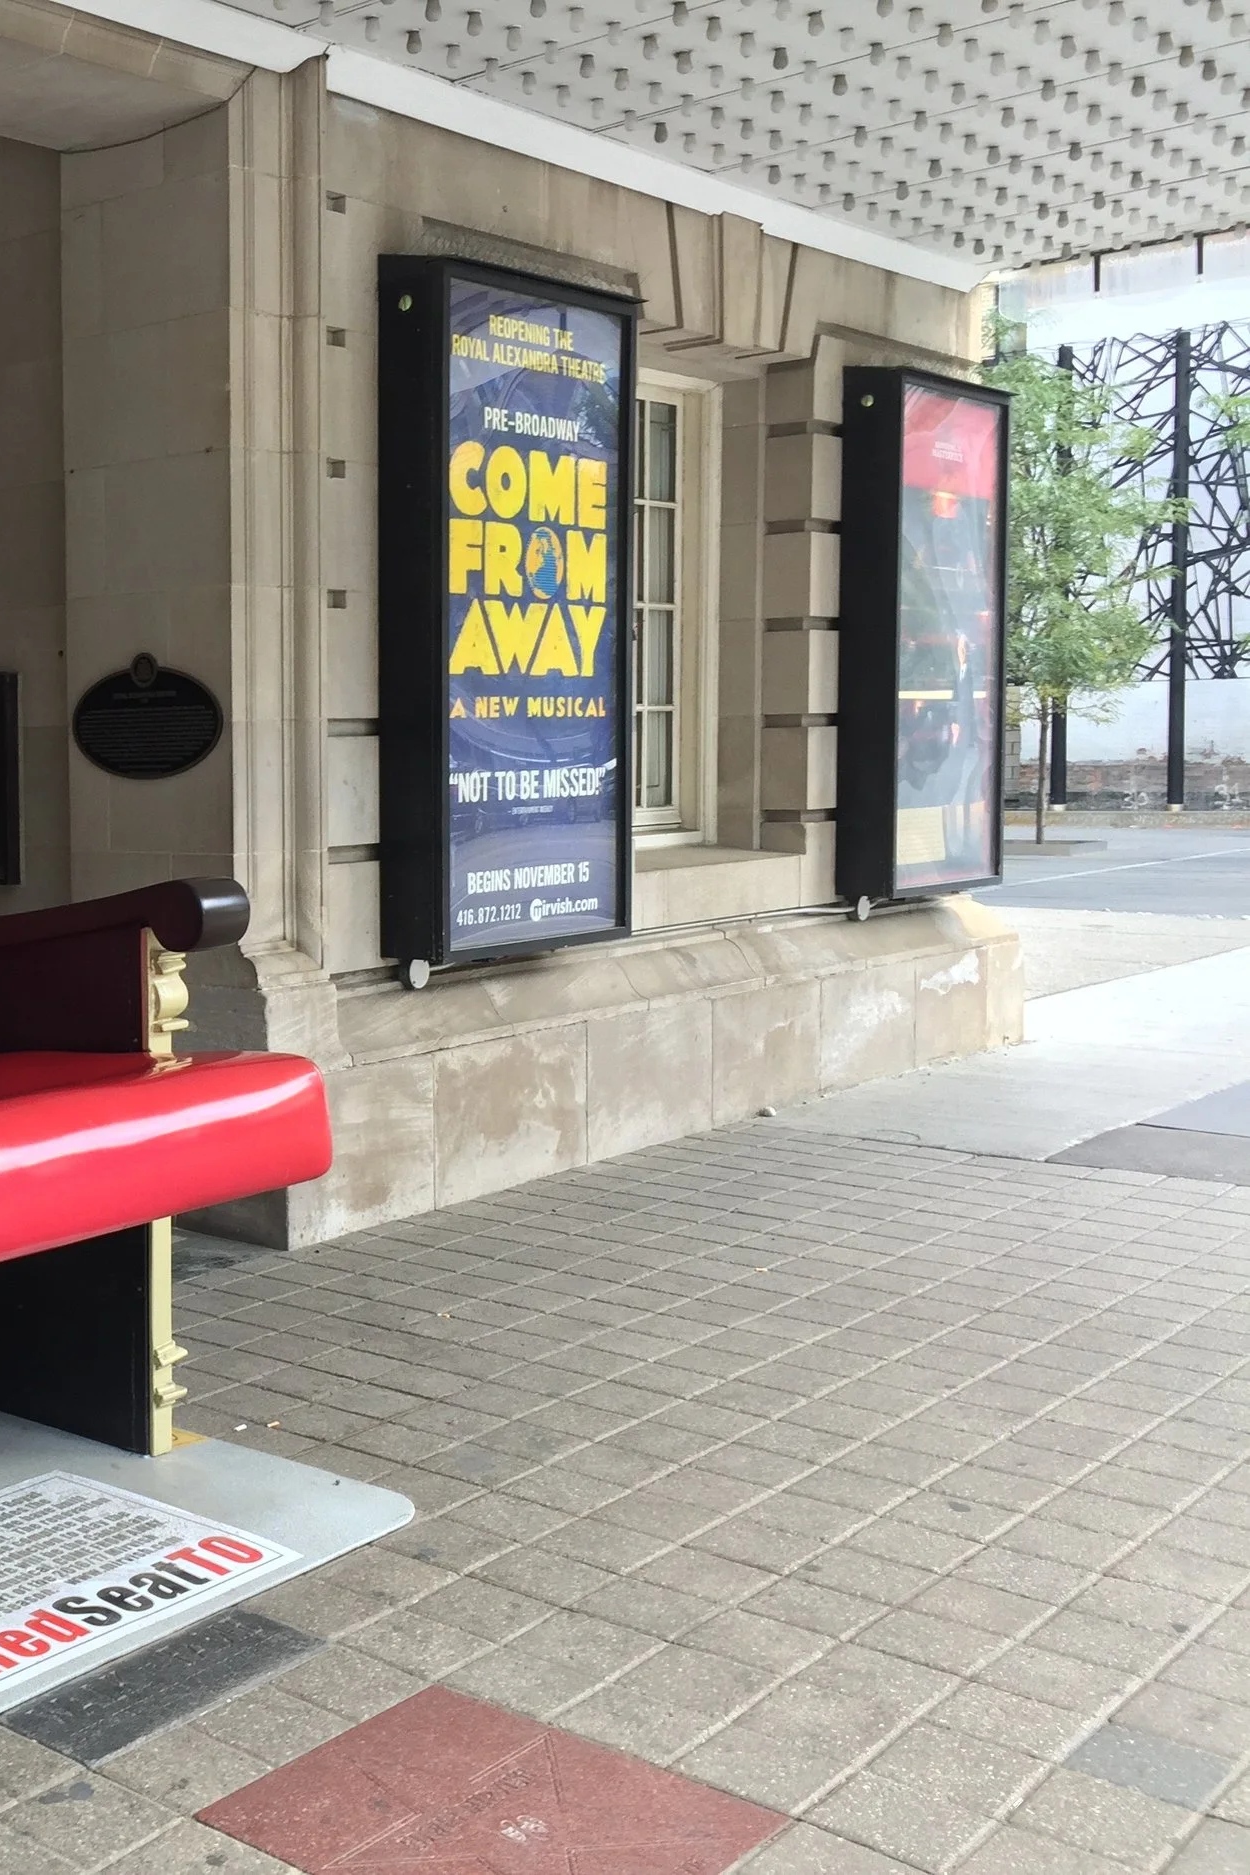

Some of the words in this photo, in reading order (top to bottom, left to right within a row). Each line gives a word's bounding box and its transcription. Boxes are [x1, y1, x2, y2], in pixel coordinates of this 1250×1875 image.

[489, 315, 550, 351] REOPENING
[553, 327, 574, 351] THE
[452, 334, 490, 362] ROYAL
[493, 340, 559, 374] ALEXANDRA
[560, 356, 606, 384] THEATRE
[484, 406, 580, 442] PRE-BROADWAY
[449, 441, 608, 530] COME
[448, 517, 606, 603] FROM
[449, 598, 606, 677] AWAY
[449, 700, 466, 719] A
[475, 696, 519, 718] NEW
[527, 696, 606, 718] MUSICAL
[495, 771, 515, 801] TO
[520, 770, 540, 800] BE
[467, 869, 510, 895] BEGINS
[514, 864, 574, 890] NOVEMBER
[578, 862, 590, 882] 15
[456, 904, 521, 926] 416.872.1212
[0, 1519, 24, 1530] we
[18, 1507, 56, 1522] have
[10, 1523, 42, 1535] The
[39, 1497, 111, 1525] renovation
[24, 1498, 52, 1510] the
[8, 1521, 77, 1547] complete
[59, 1531, 80, 1540] to
[76, 1519, 109, 1534] play
[103, 1511, 131, 1522] the
[14, 1555, 46, 1570] will
[39, 1548, 64, 1558] be
[59, 1539, 88, 1551] the
[52, 1547, 95, 1565] COME
[11, 1584, 32, 1595] of
[26, 1575, 57, 1588] the
